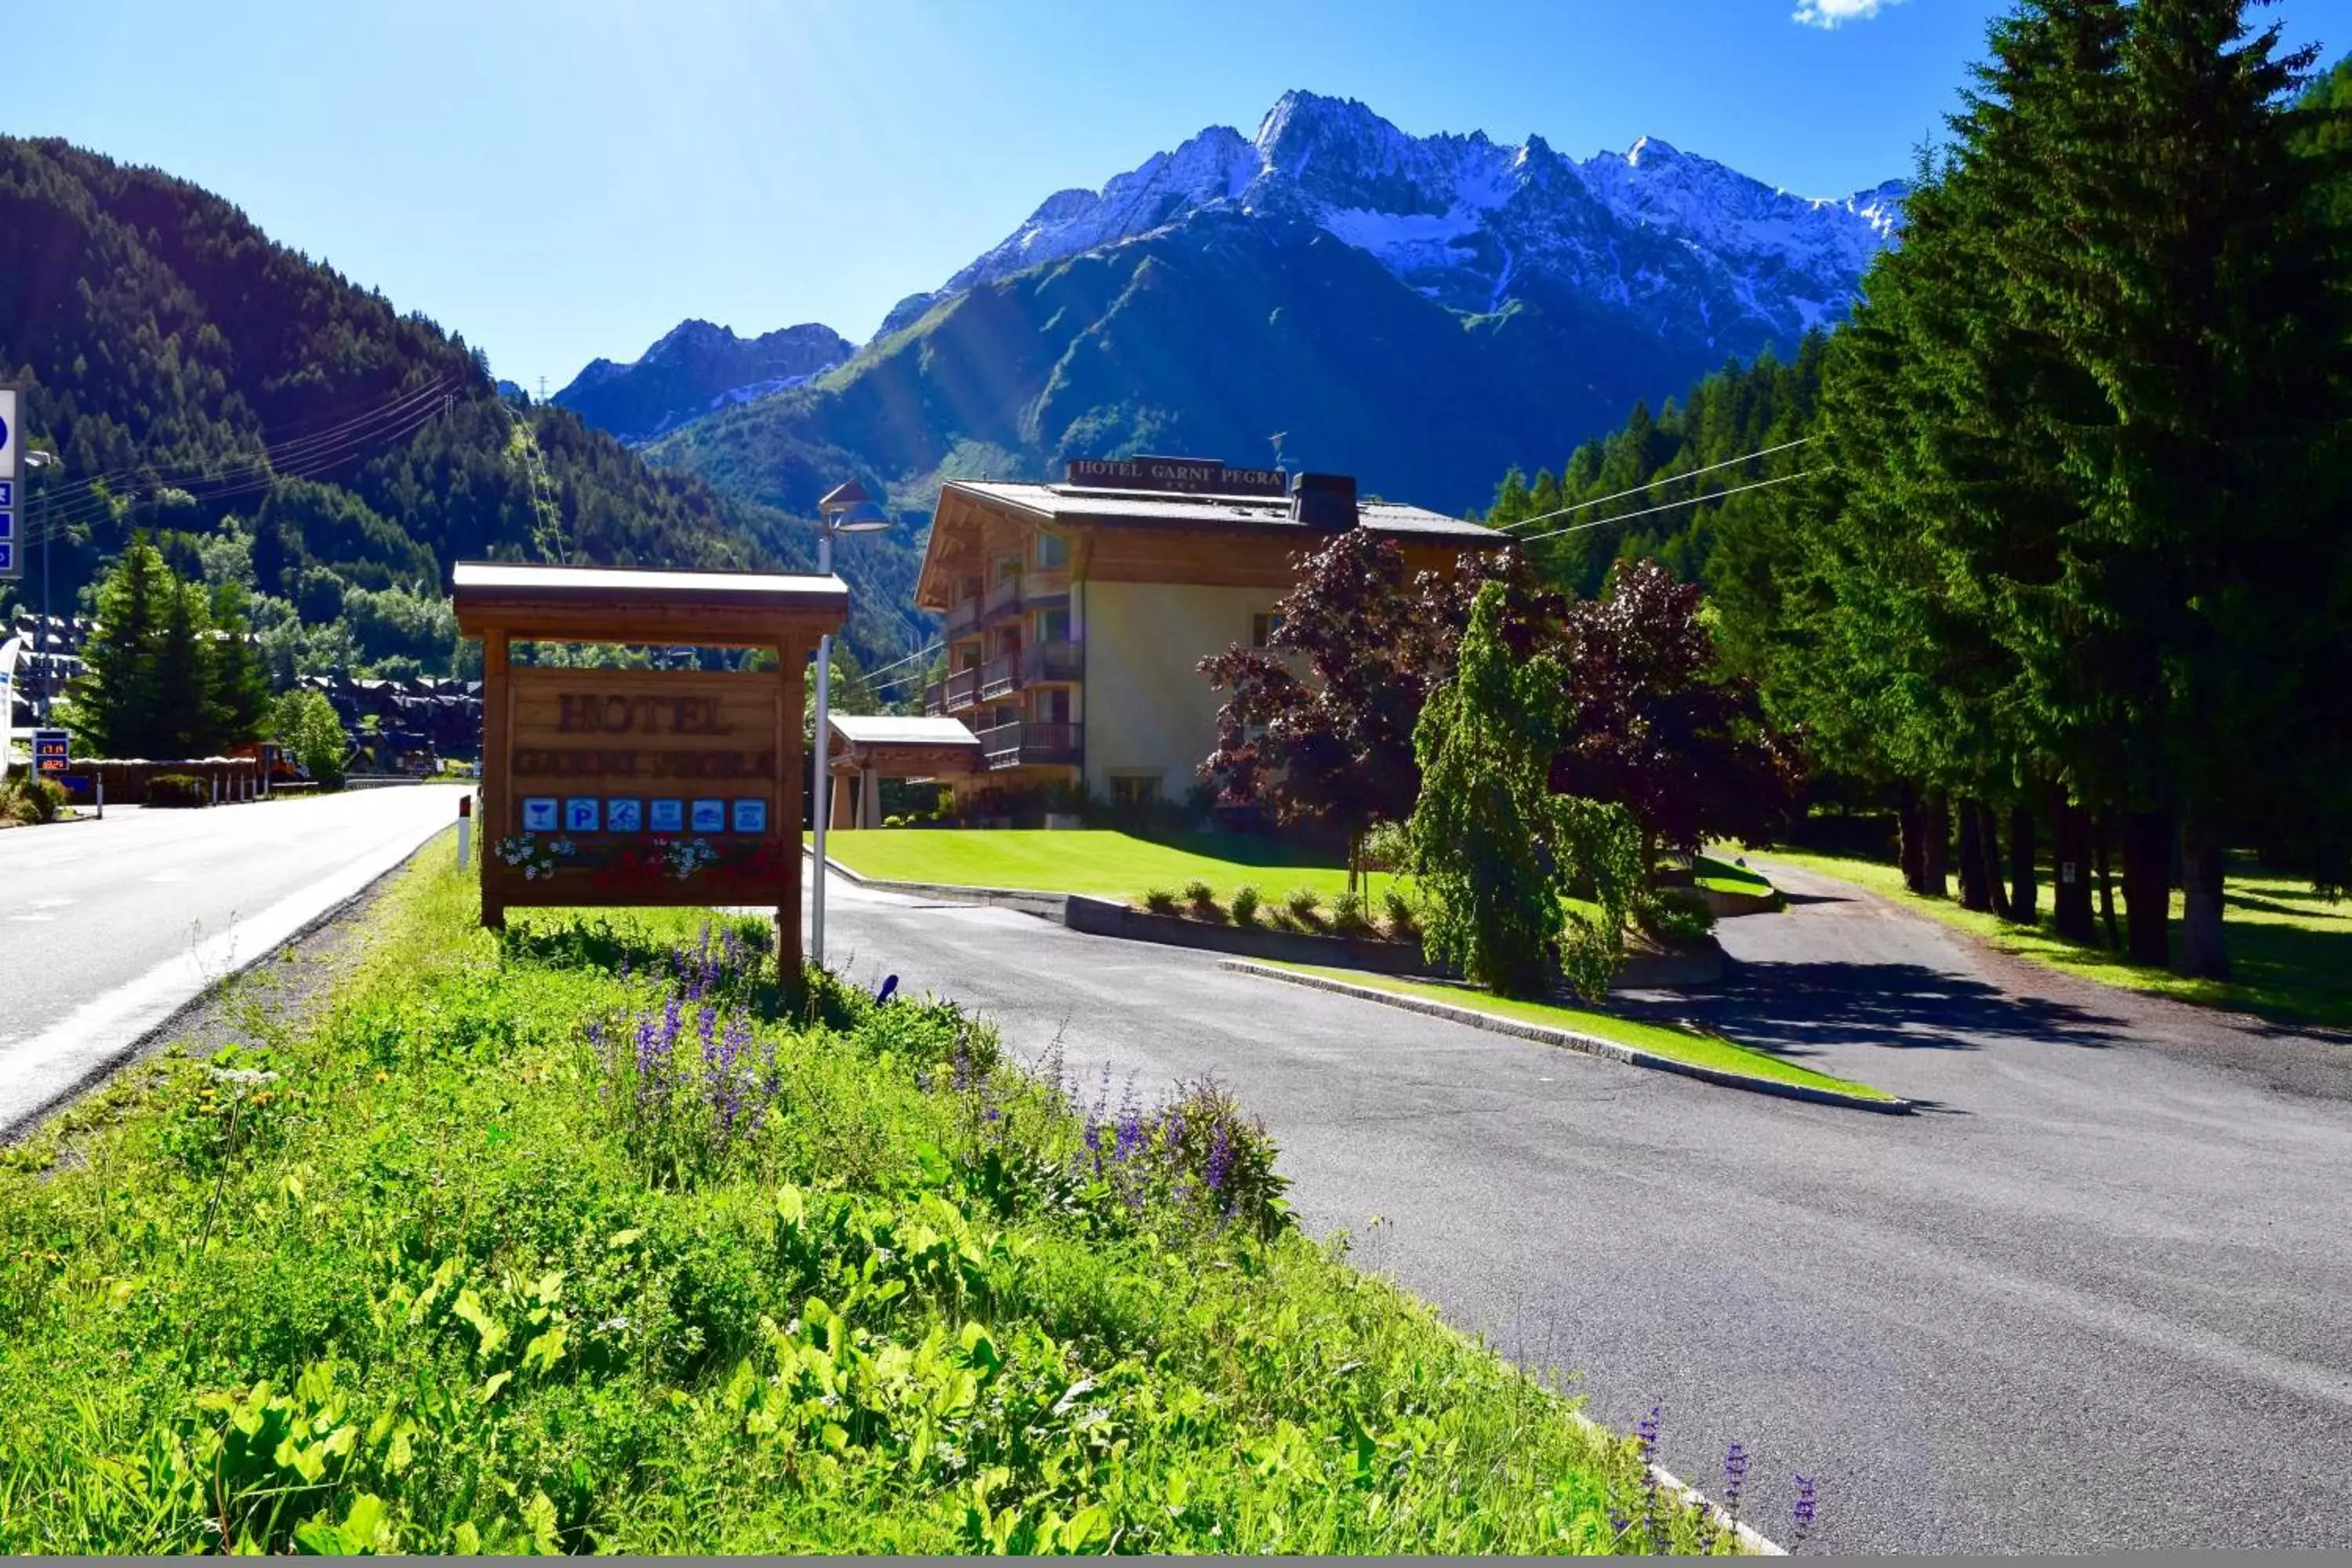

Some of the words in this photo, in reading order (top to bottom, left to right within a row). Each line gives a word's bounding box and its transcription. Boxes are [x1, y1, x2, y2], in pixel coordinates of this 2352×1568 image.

[1079, 459, 1142, 477] HOTEL
[558, 693, 734, 735] HOTEL
[575, 808, 593, 828] P
